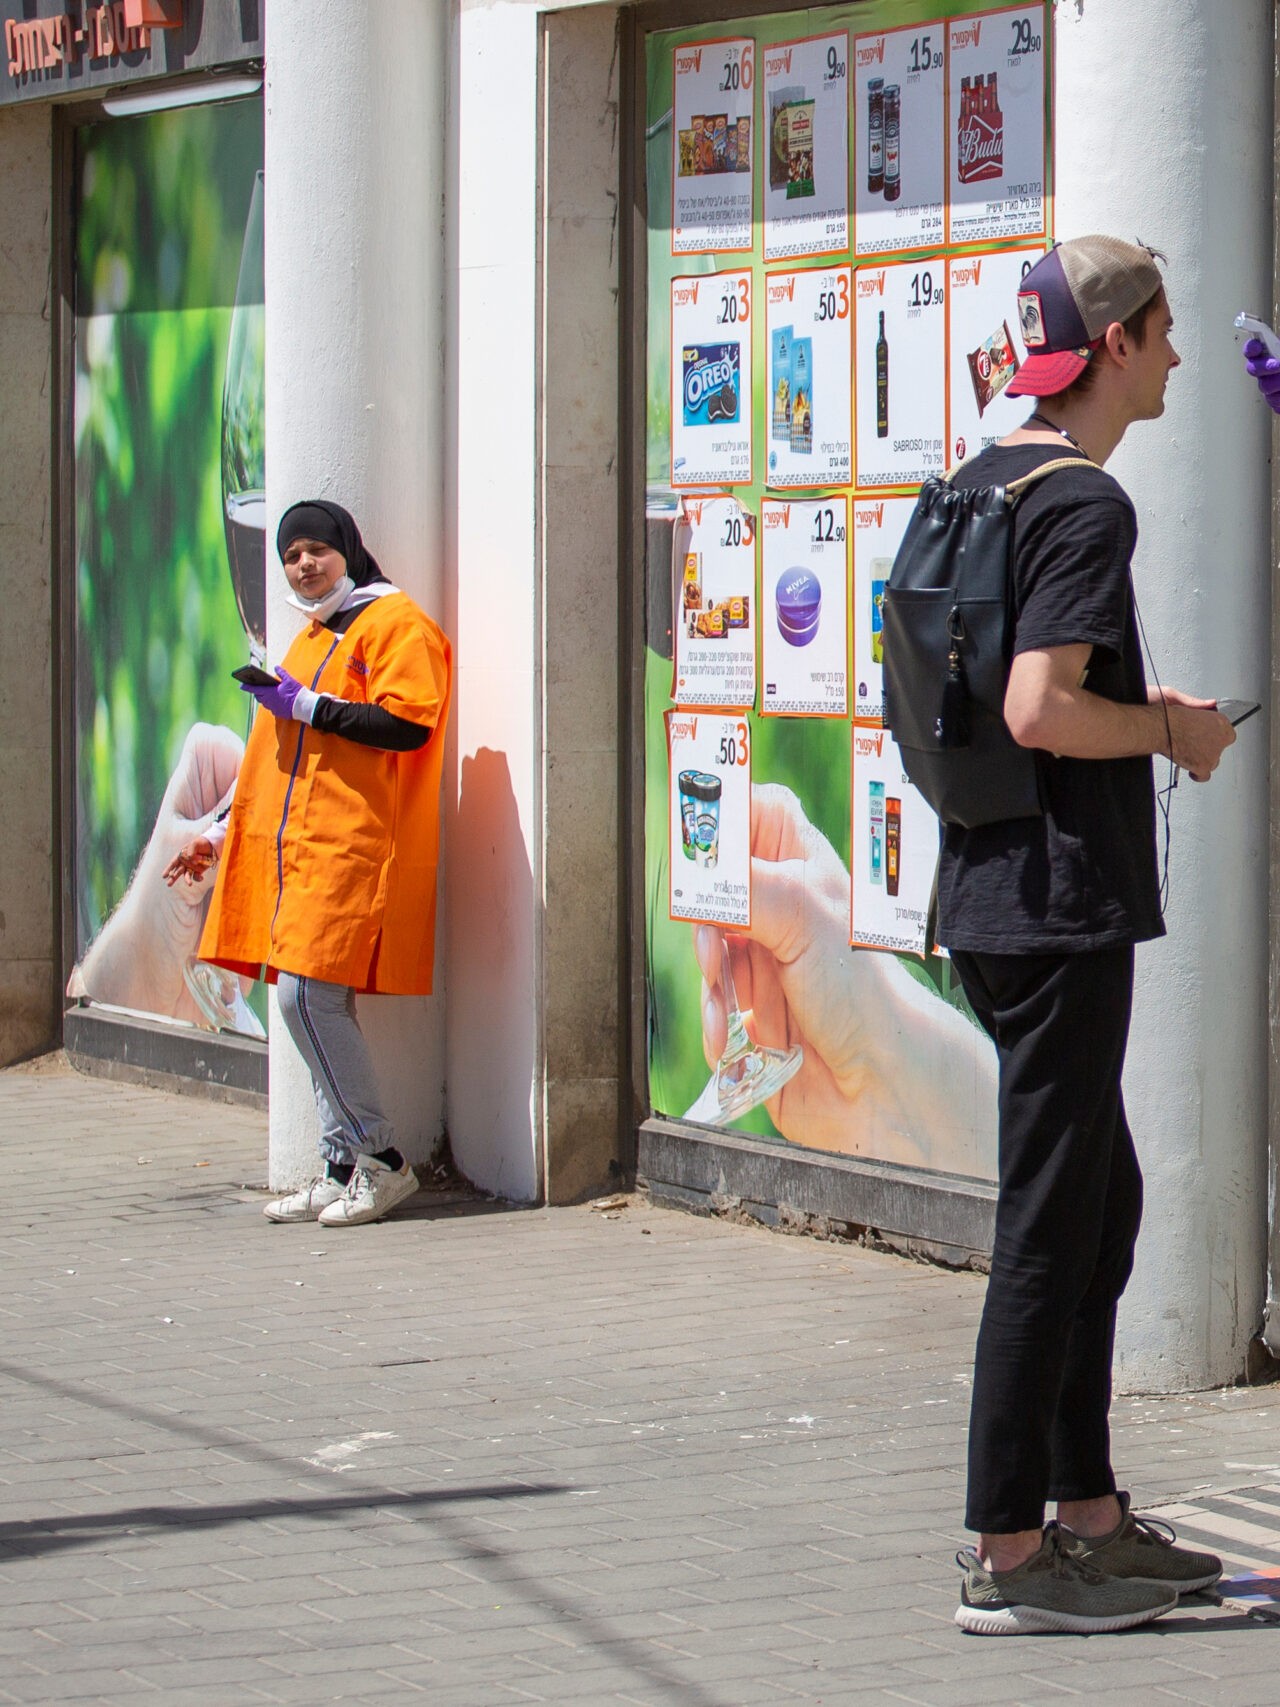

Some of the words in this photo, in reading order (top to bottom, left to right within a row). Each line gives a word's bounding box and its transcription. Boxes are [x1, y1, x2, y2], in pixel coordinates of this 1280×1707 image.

[741, 46, 753, 90] 6
[738, 278, 750, 322] 3
[837, 274, 849, 319] 3
[687, 361, 731, 404] OREO
[785, 575, 809, 595] NIVEA
[737, 722, 749, 766] 3
